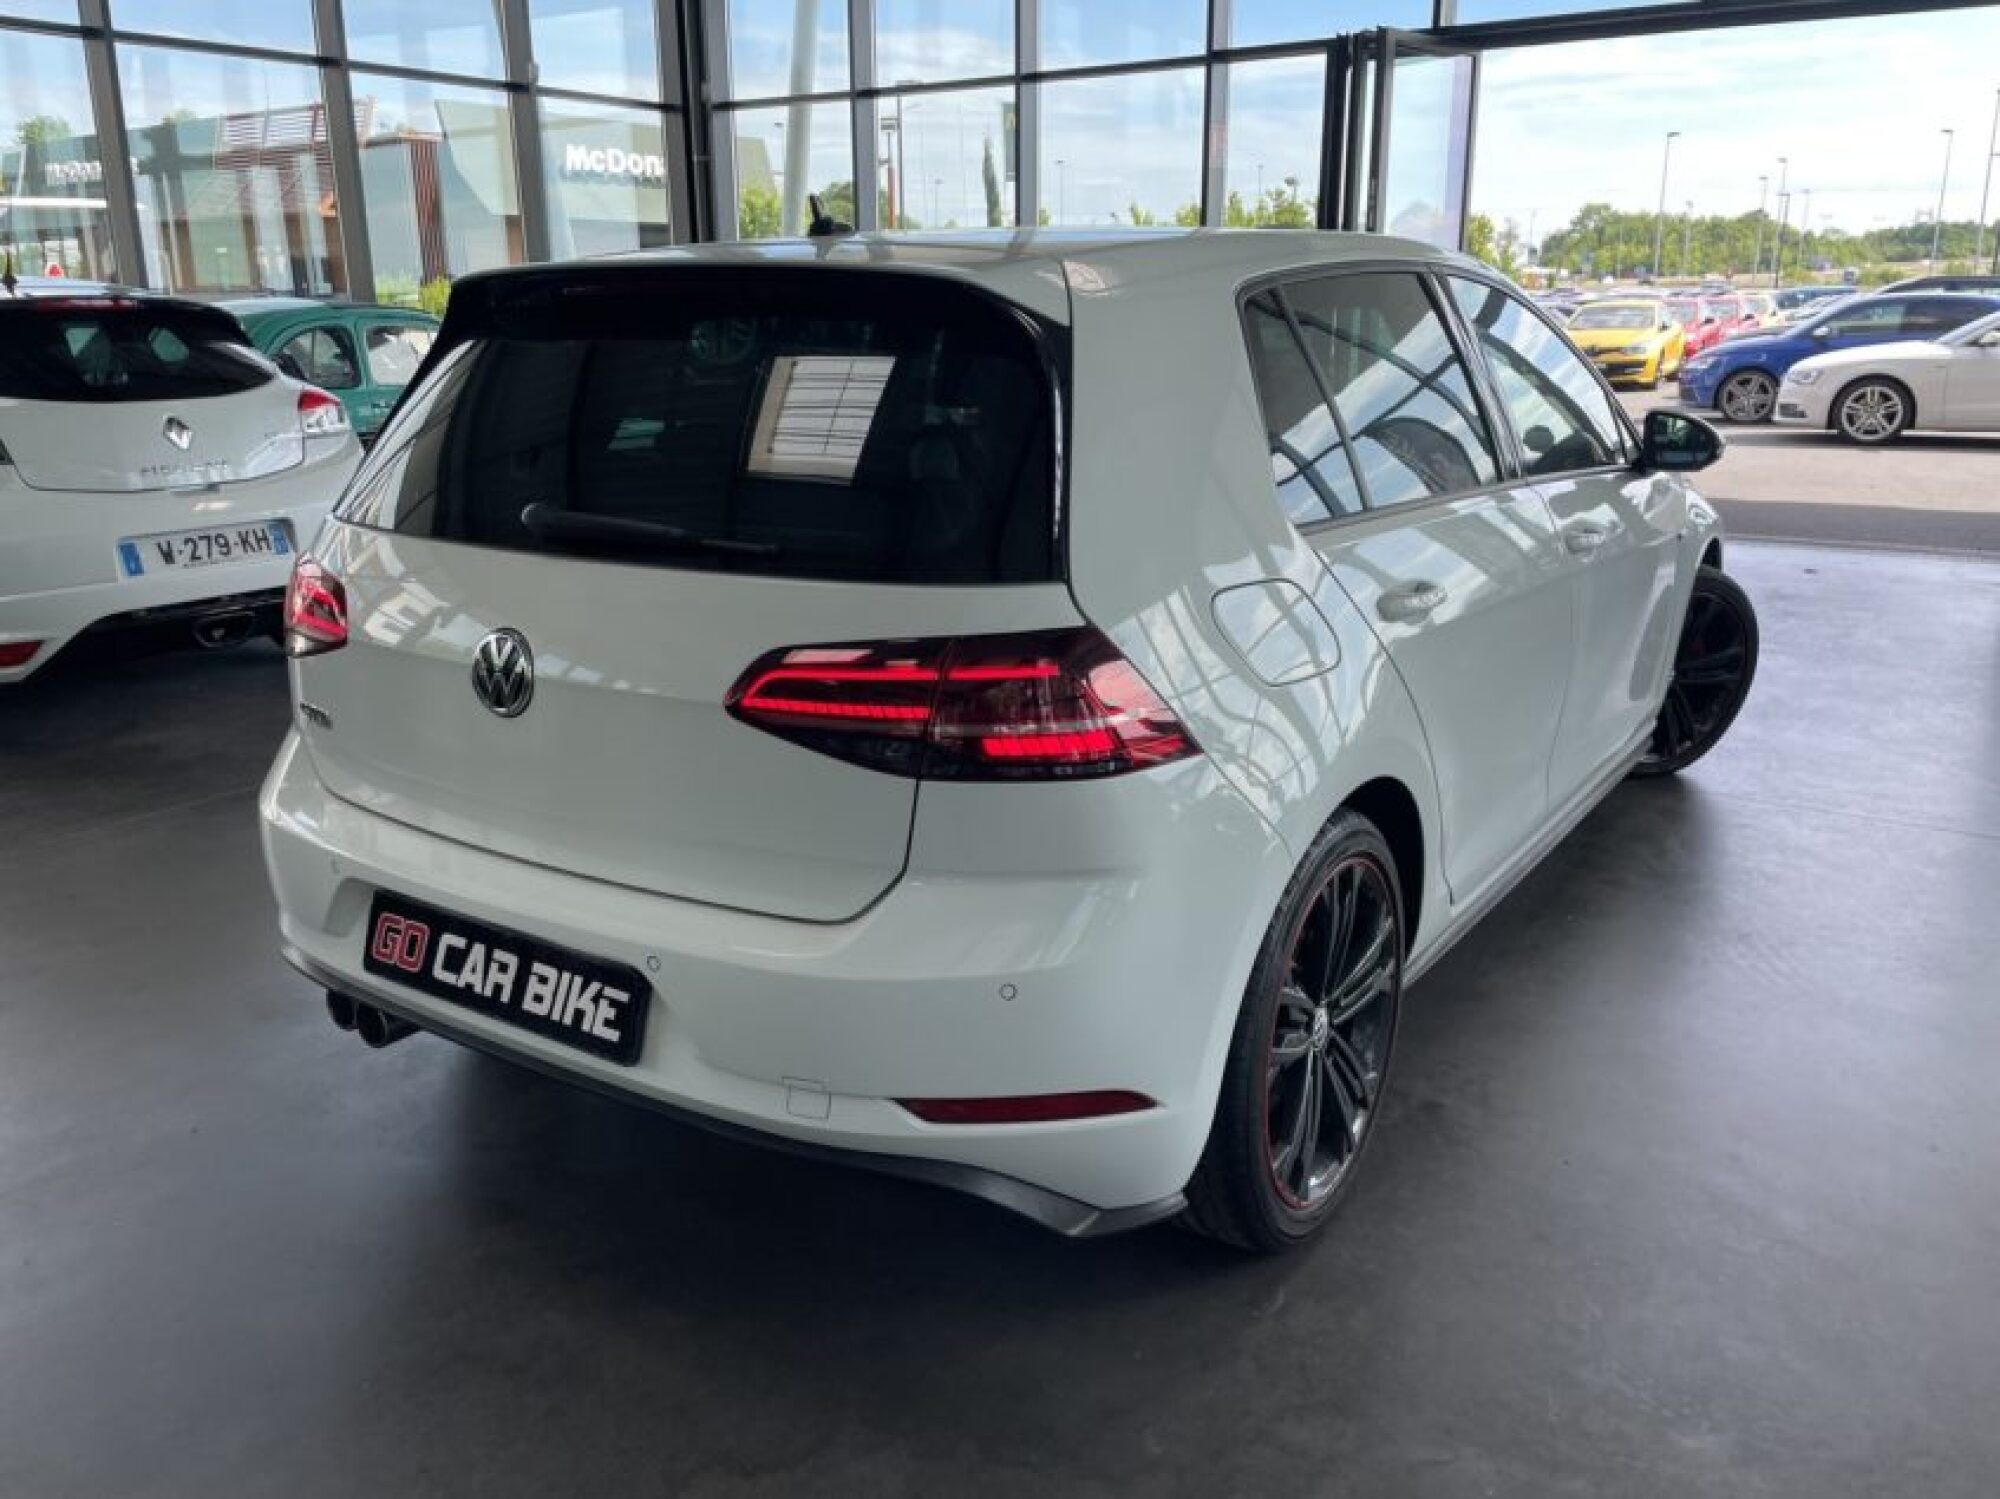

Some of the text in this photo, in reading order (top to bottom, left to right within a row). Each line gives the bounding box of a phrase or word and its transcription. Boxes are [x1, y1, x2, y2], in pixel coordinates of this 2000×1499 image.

[566, 143, 664, 177] McDon
[372, 912, 631, 1042] GO CAR BIKE
